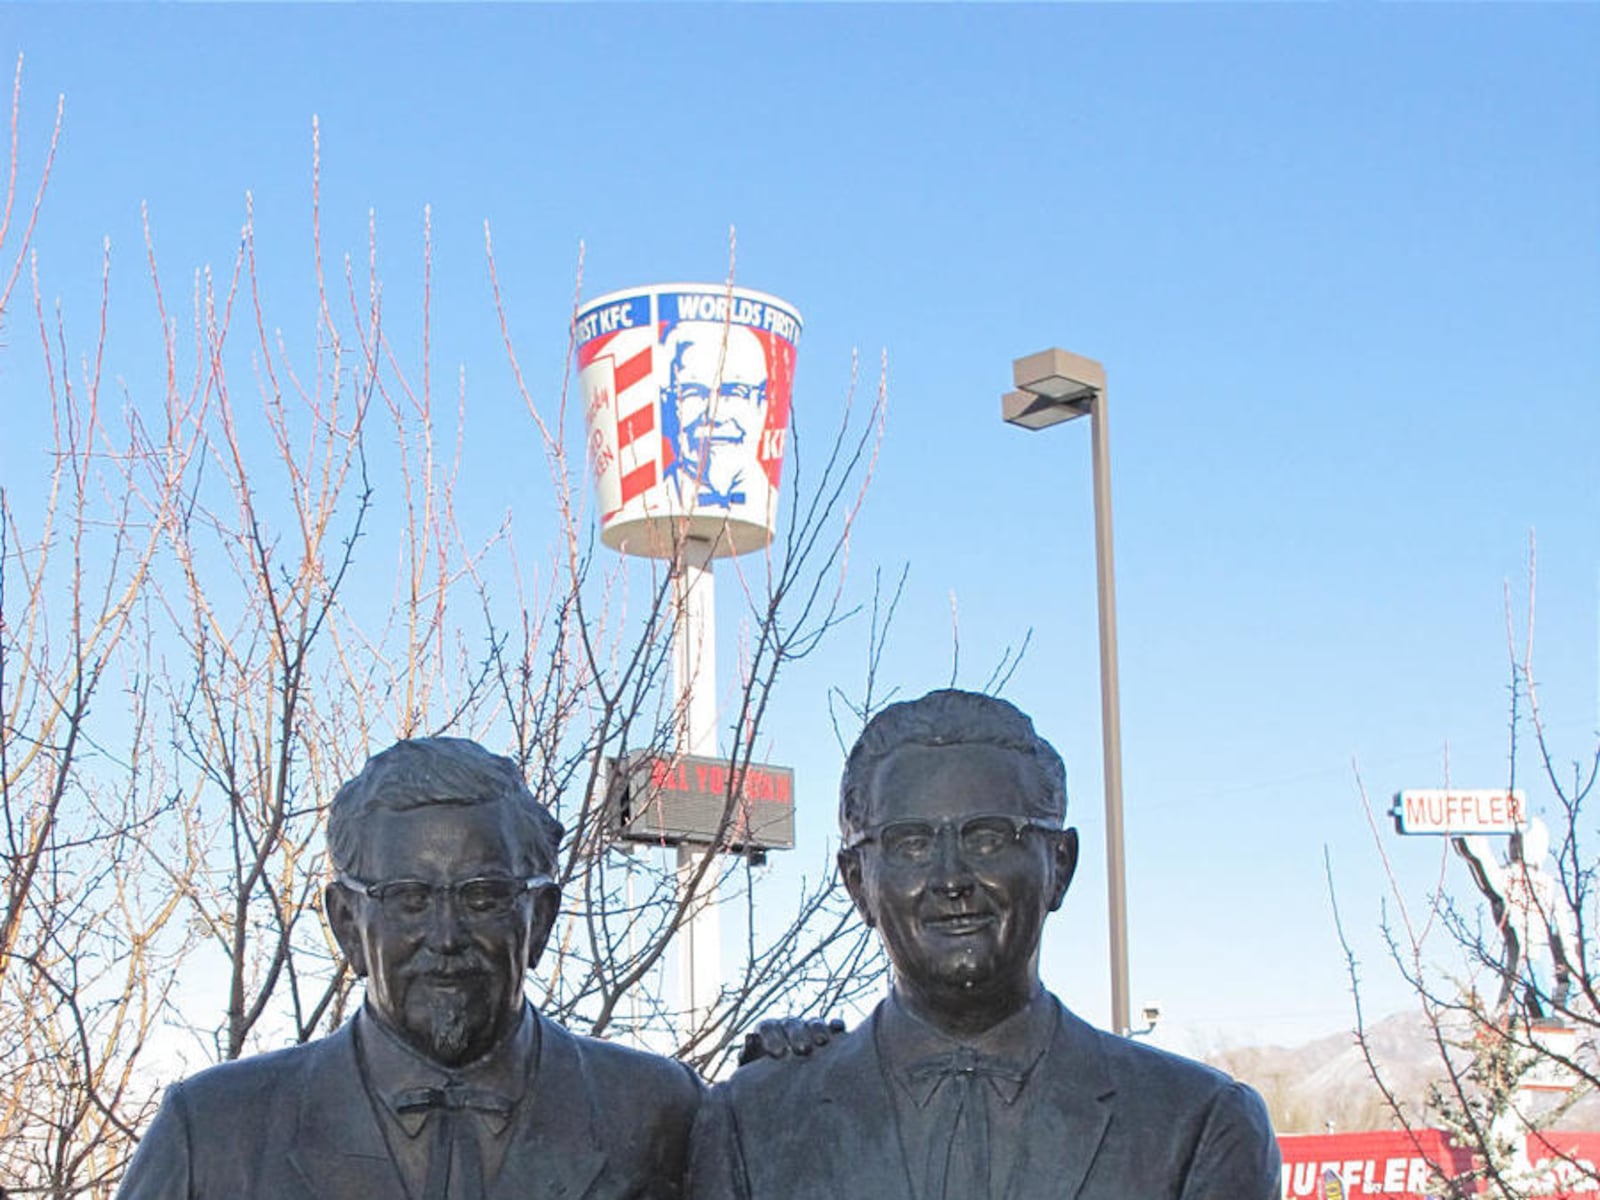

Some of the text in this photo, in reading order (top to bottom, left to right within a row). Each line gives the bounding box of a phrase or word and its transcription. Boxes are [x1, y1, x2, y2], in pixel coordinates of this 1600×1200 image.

[600, 302, 634, 335] KFC
[678, 295, 763, 329] WORLDS
[1405, 796, 1528, 826] MUFFLER
